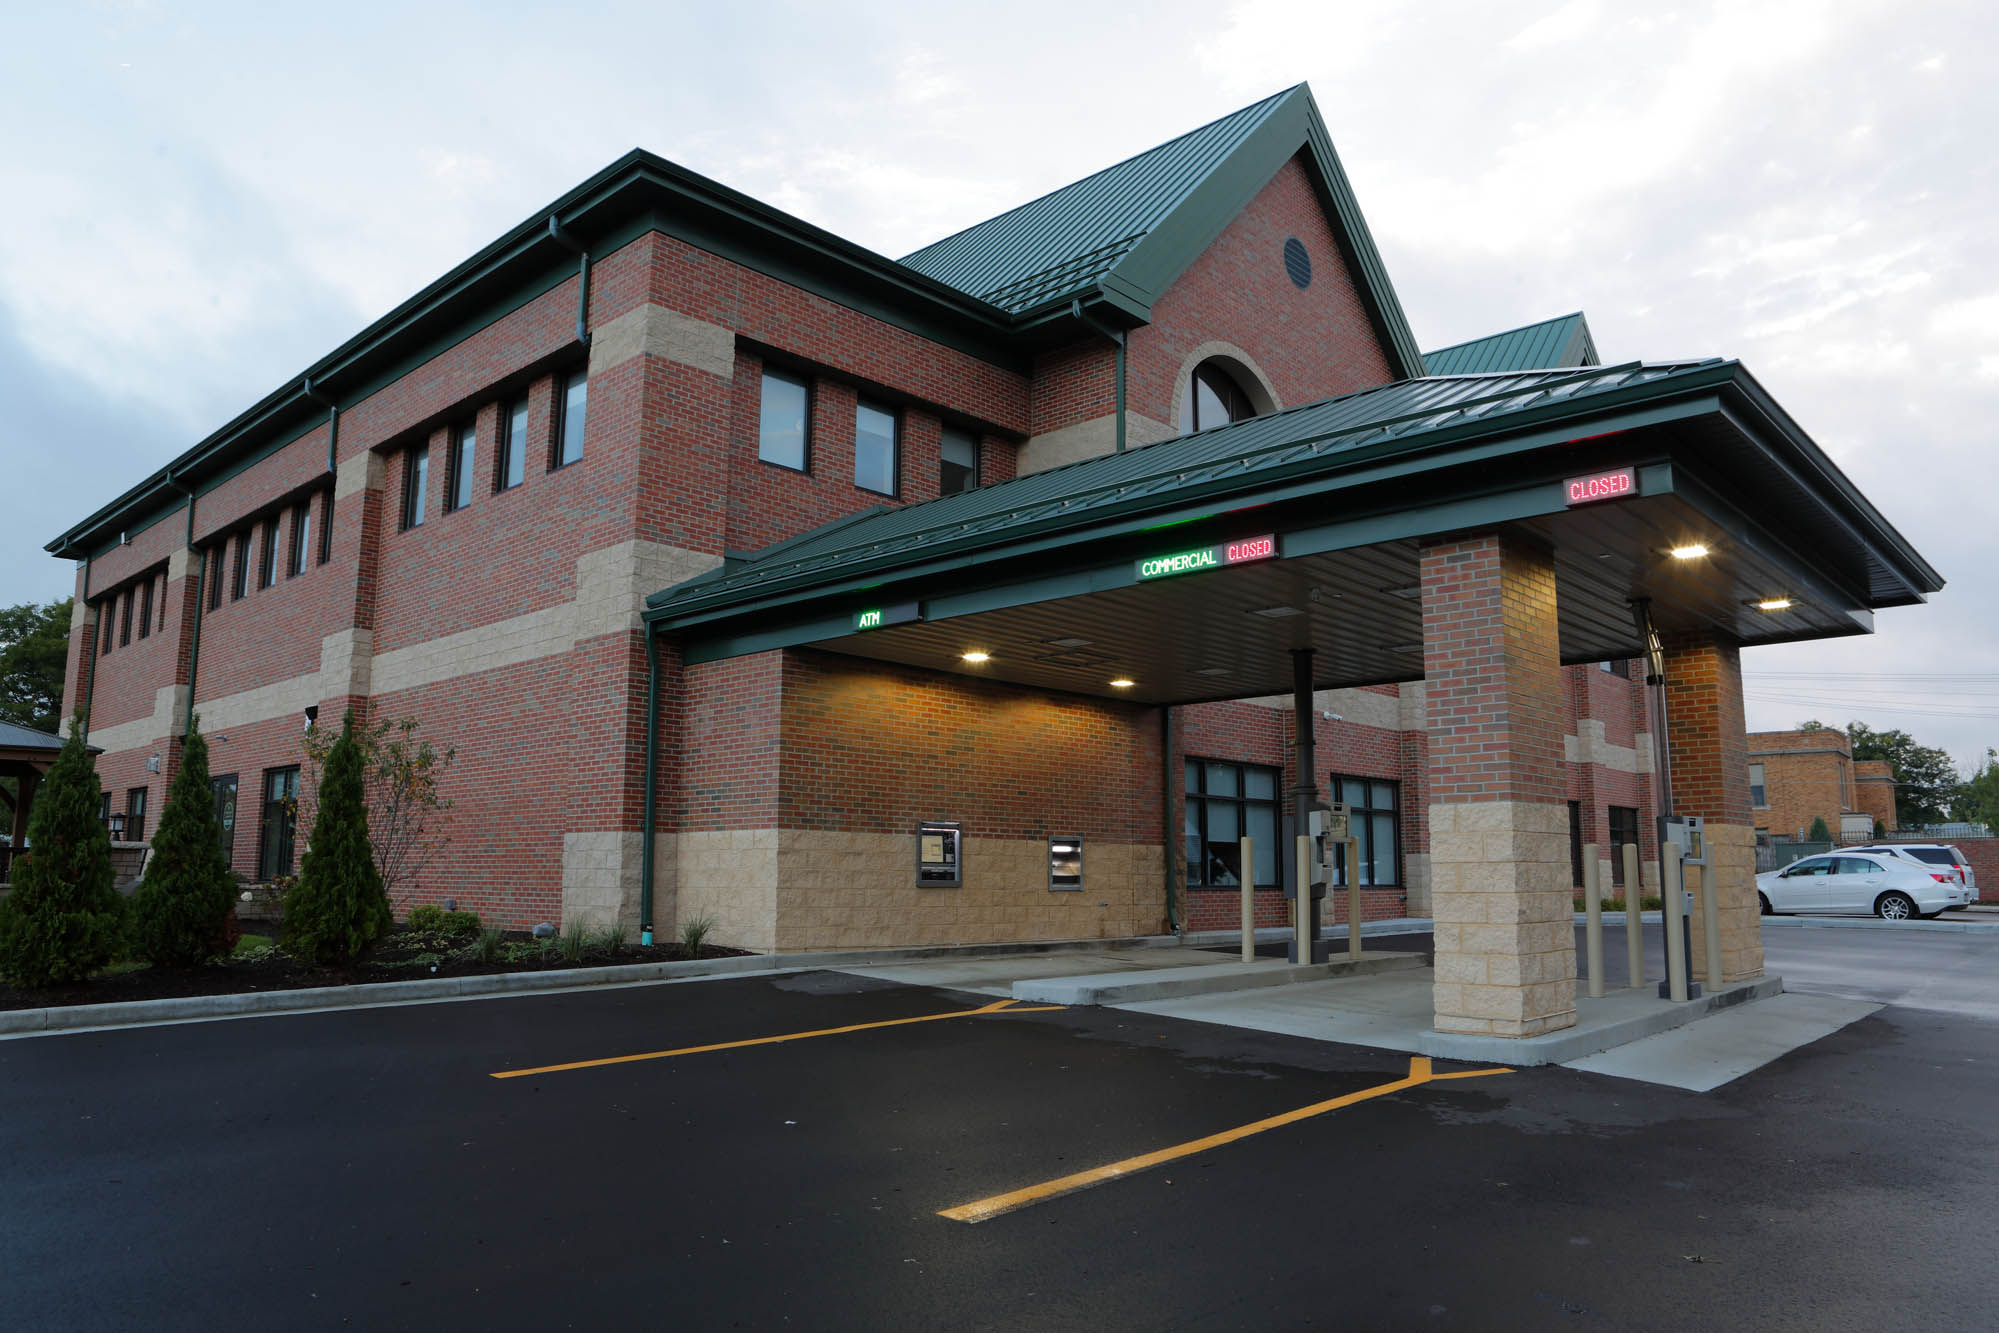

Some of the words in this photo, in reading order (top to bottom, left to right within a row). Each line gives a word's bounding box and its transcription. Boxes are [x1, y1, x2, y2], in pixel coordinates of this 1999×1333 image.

[1569, 473, 1630, 500] CLOSED
[1142, 550, 1217, 576] COMMERCIAL
[1228, 539, 1271, 561] CLOSED
[859, 611, 880, 628] ATM
